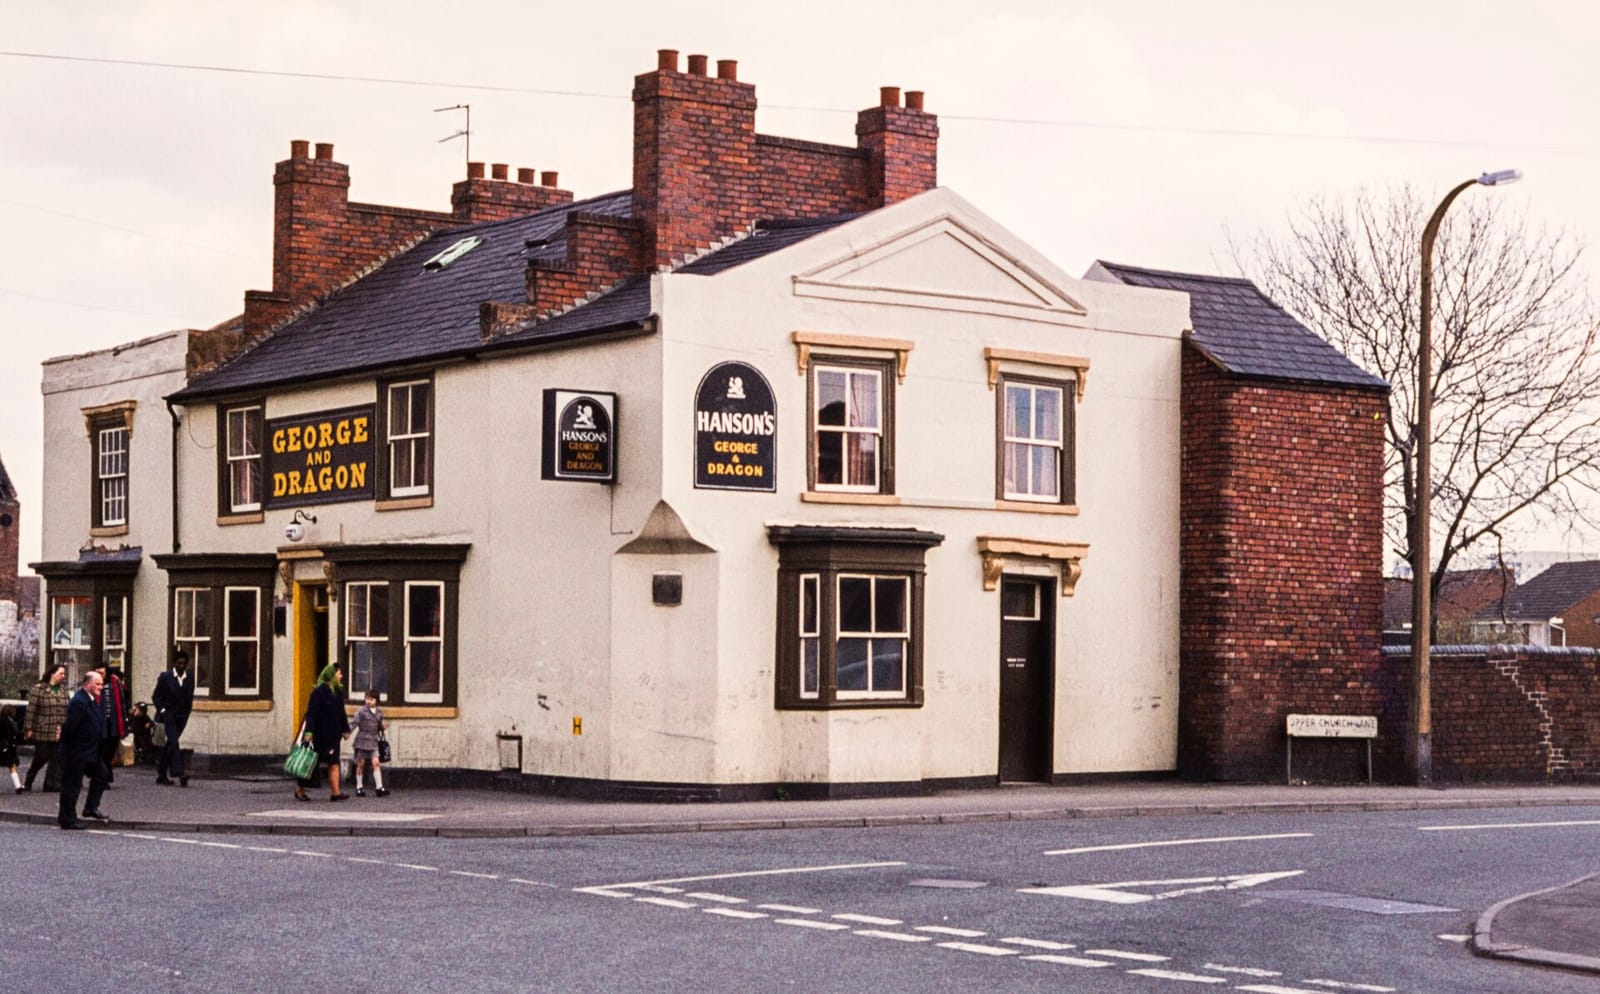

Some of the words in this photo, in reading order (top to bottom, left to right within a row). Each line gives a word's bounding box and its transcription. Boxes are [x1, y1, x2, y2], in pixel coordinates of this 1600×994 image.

[697, 410, 774, 435] HANSON'S
[272, 417, 368, 453] GEORGE
[562, 430, 607, 443] HANSON'S
[568, 442, 600, 451] GEORGE
[714, 440, 758, 454] GEORGE
[306, 450, 331, 466] AND
[576, 452, 594, 460] AND
[566, 461, 602, 470] DRAGON
[707, 463, 763, 477] DRAGON
[273, 462, 367, 497] DRAGON
[1290, 718, 1316, 728] UPPER
[1319, 719, 1353, 728] CHURCH
